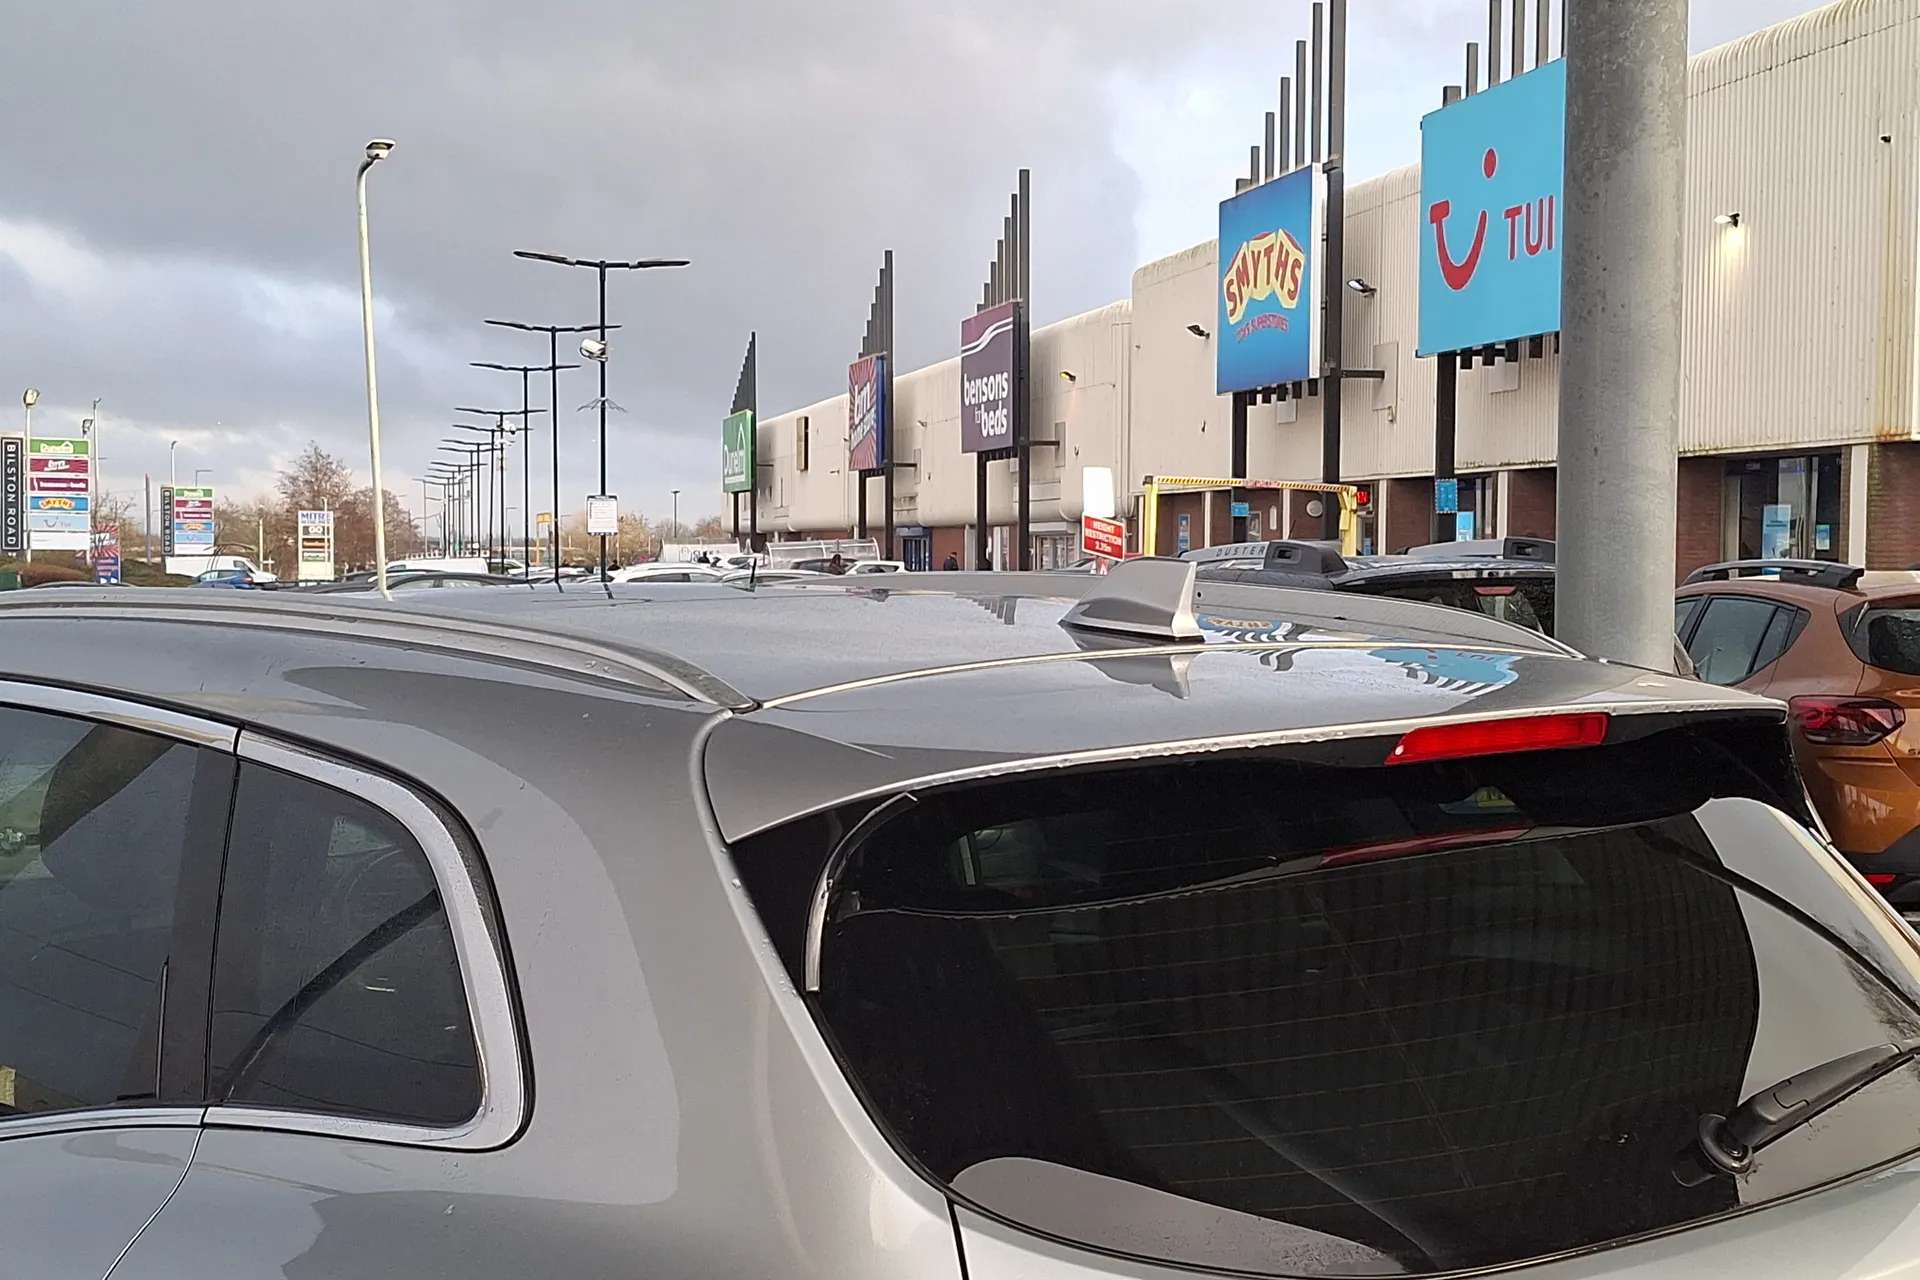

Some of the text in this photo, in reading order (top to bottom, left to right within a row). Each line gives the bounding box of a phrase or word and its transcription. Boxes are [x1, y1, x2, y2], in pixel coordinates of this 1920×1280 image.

[1503, 194, 1555, 261] TUI
[1225, 239, 1303, 318] SMYTHS
[963, 371, 1009, 406] bensons
[981, 400, 1007, 437] beds
[6, 443, 17, 545] BILSTON ROAD
[1215, 545, 1266, 558] DUSTER
